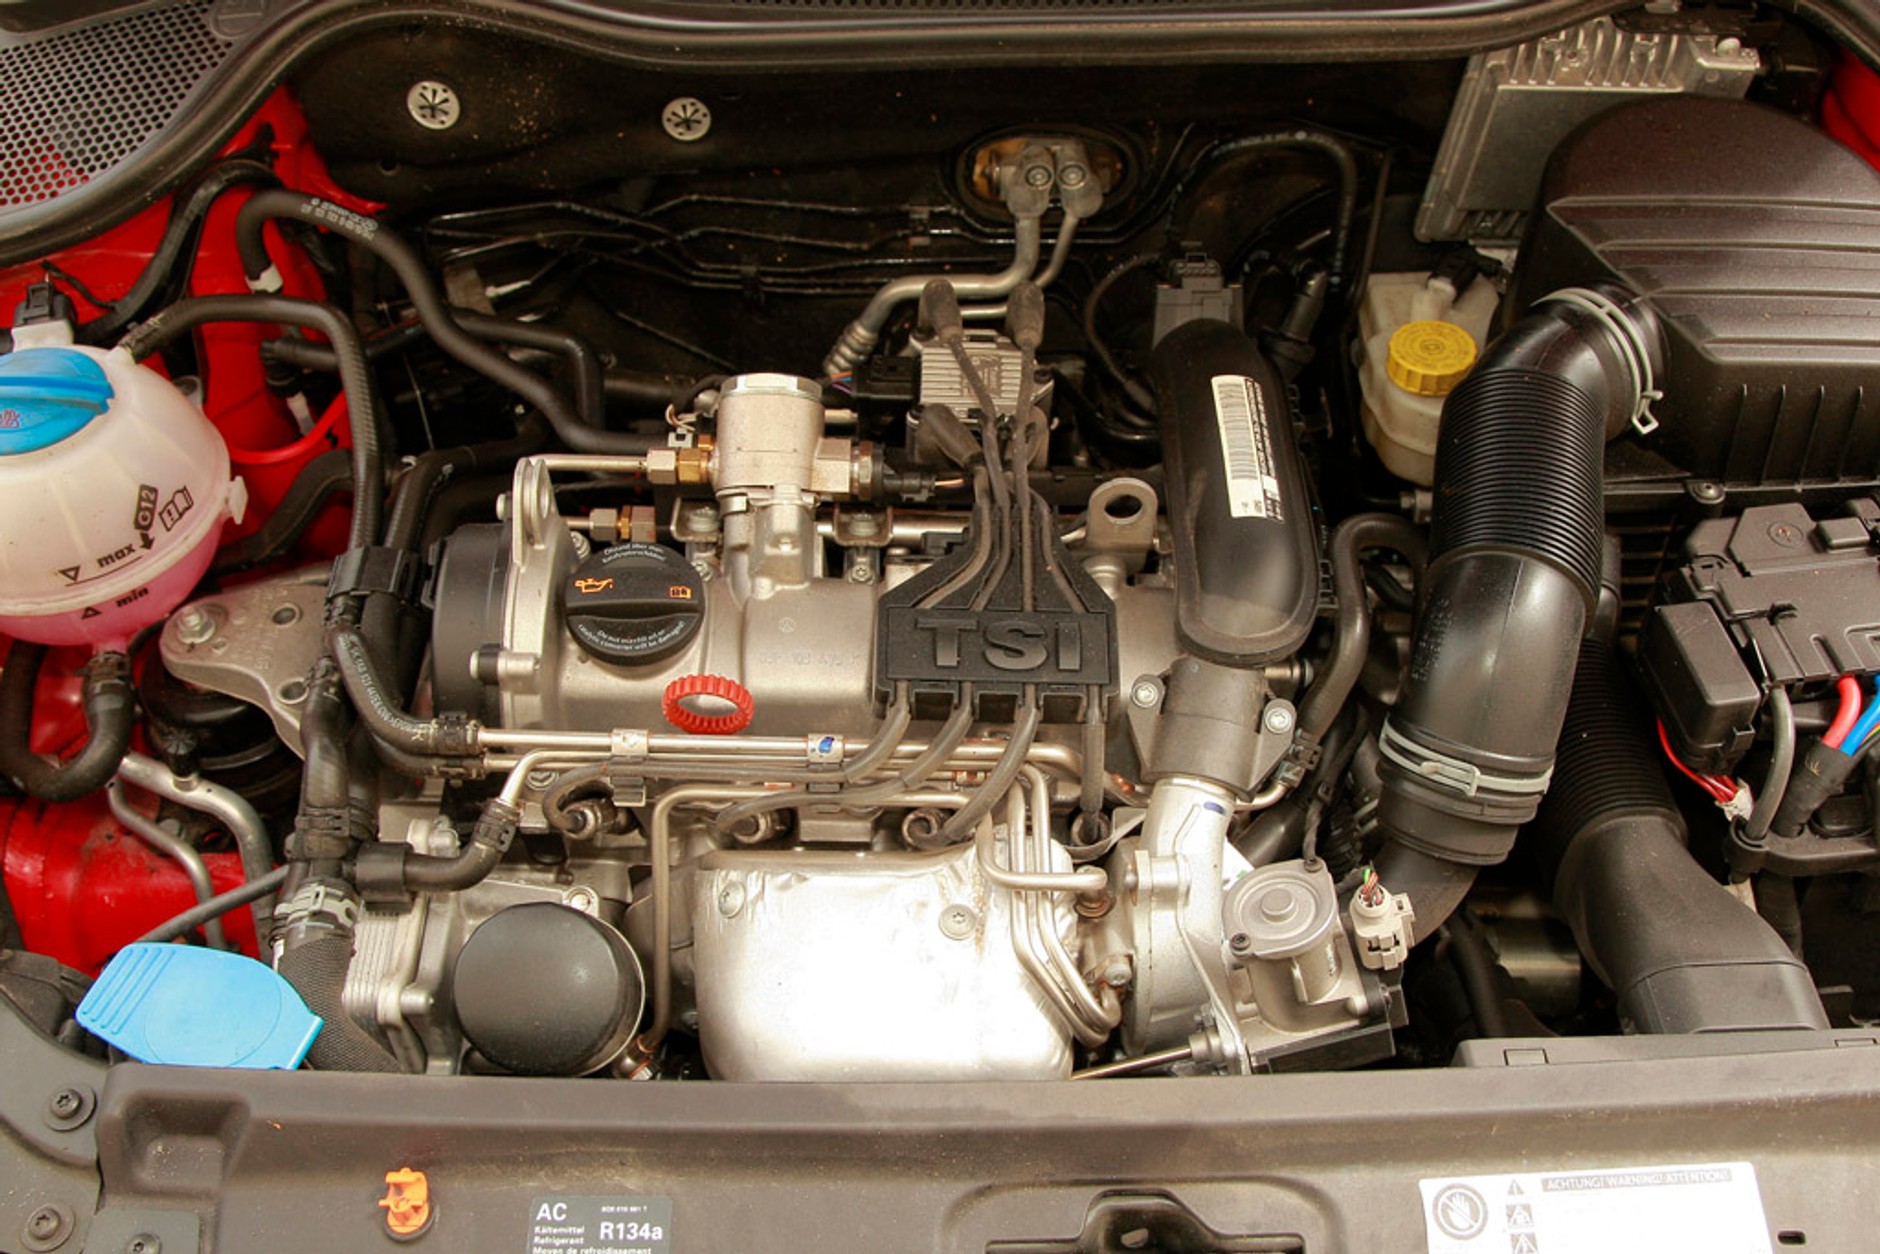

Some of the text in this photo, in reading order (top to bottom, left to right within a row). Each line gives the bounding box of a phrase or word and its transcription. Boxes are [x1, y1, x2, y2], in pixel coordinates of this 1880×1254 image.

[97, 544, 135, 567] max
[116, 587, 149, 607] min
[916, 618, 1082, 671] TSI
[536, 1202, 567, 1221] AC
[600, 1221, 663, 1240] R134a
[534, 1236, 584, 1246] Refrigerant
